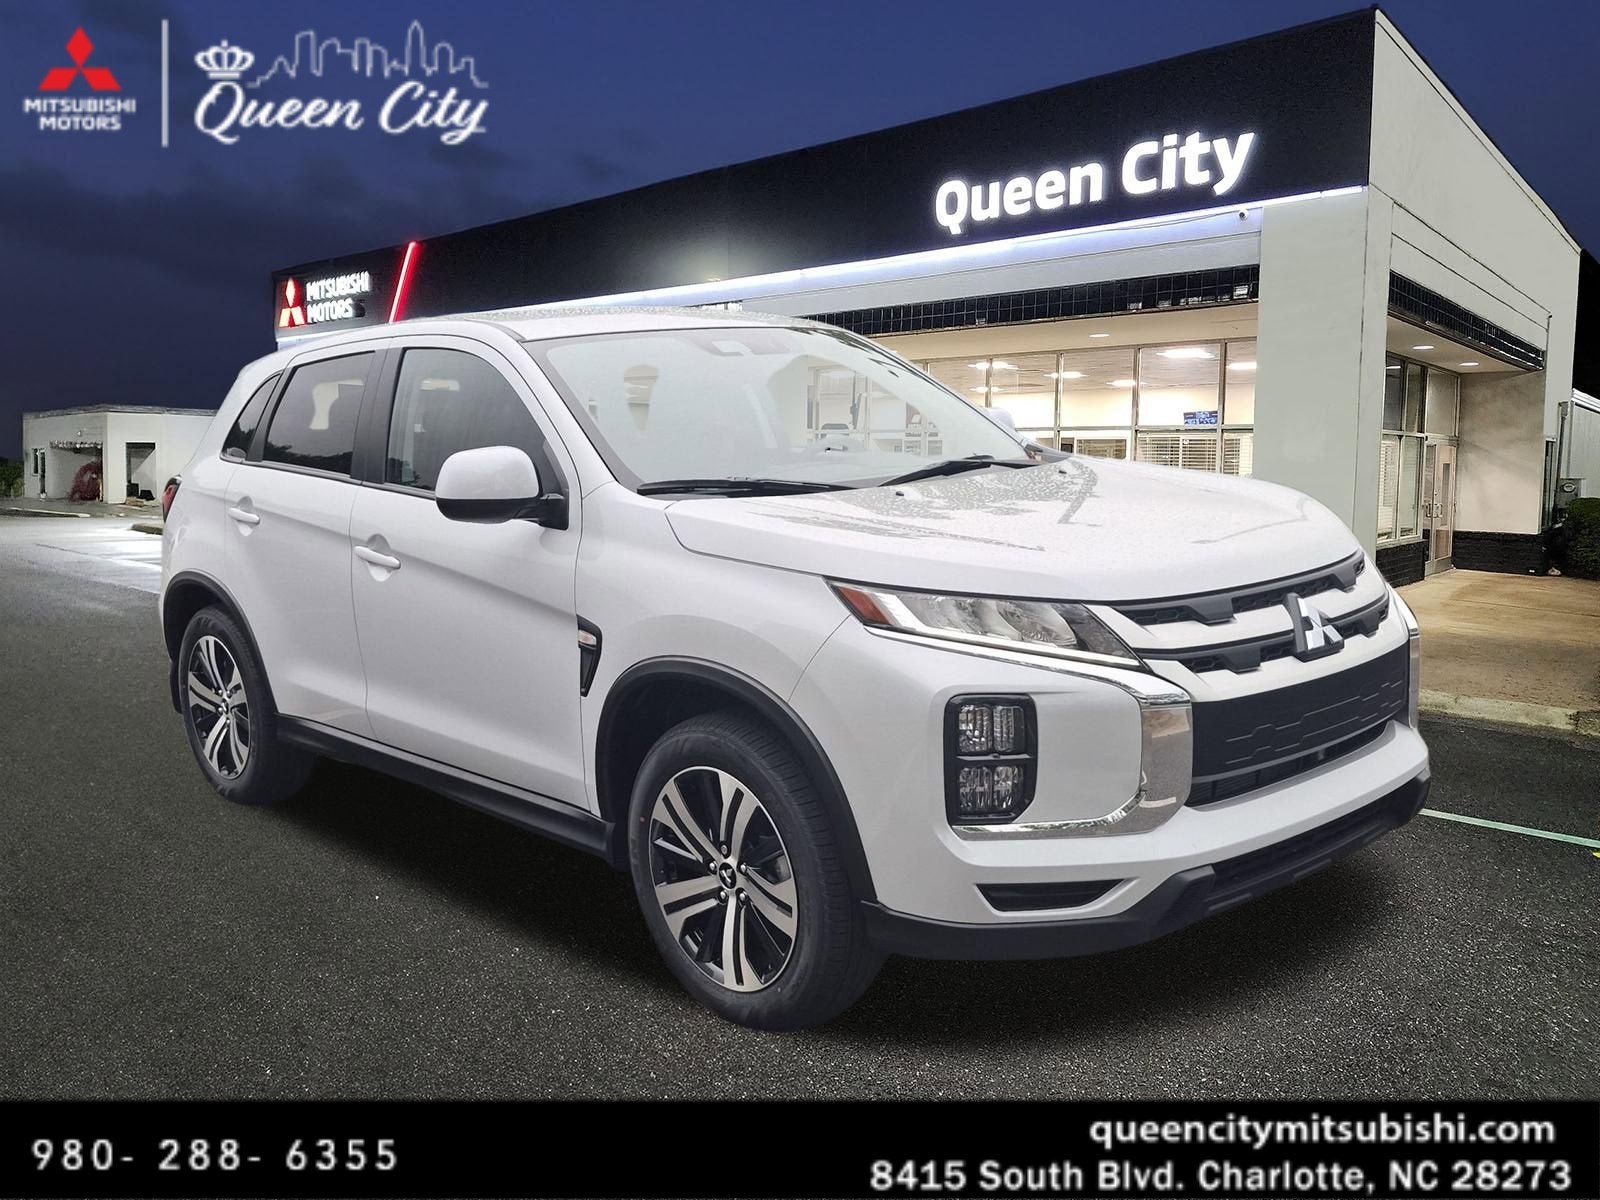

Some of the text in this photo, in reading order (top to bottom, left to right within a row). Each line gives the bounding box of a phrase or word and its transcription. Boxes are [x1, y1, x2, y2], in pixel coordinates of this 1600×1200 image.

[935, 131, 1255, 235] Queen City
[306, 270, 370, 301] MITSUBISHI
[306, 297, 355, 324] MOTORS
